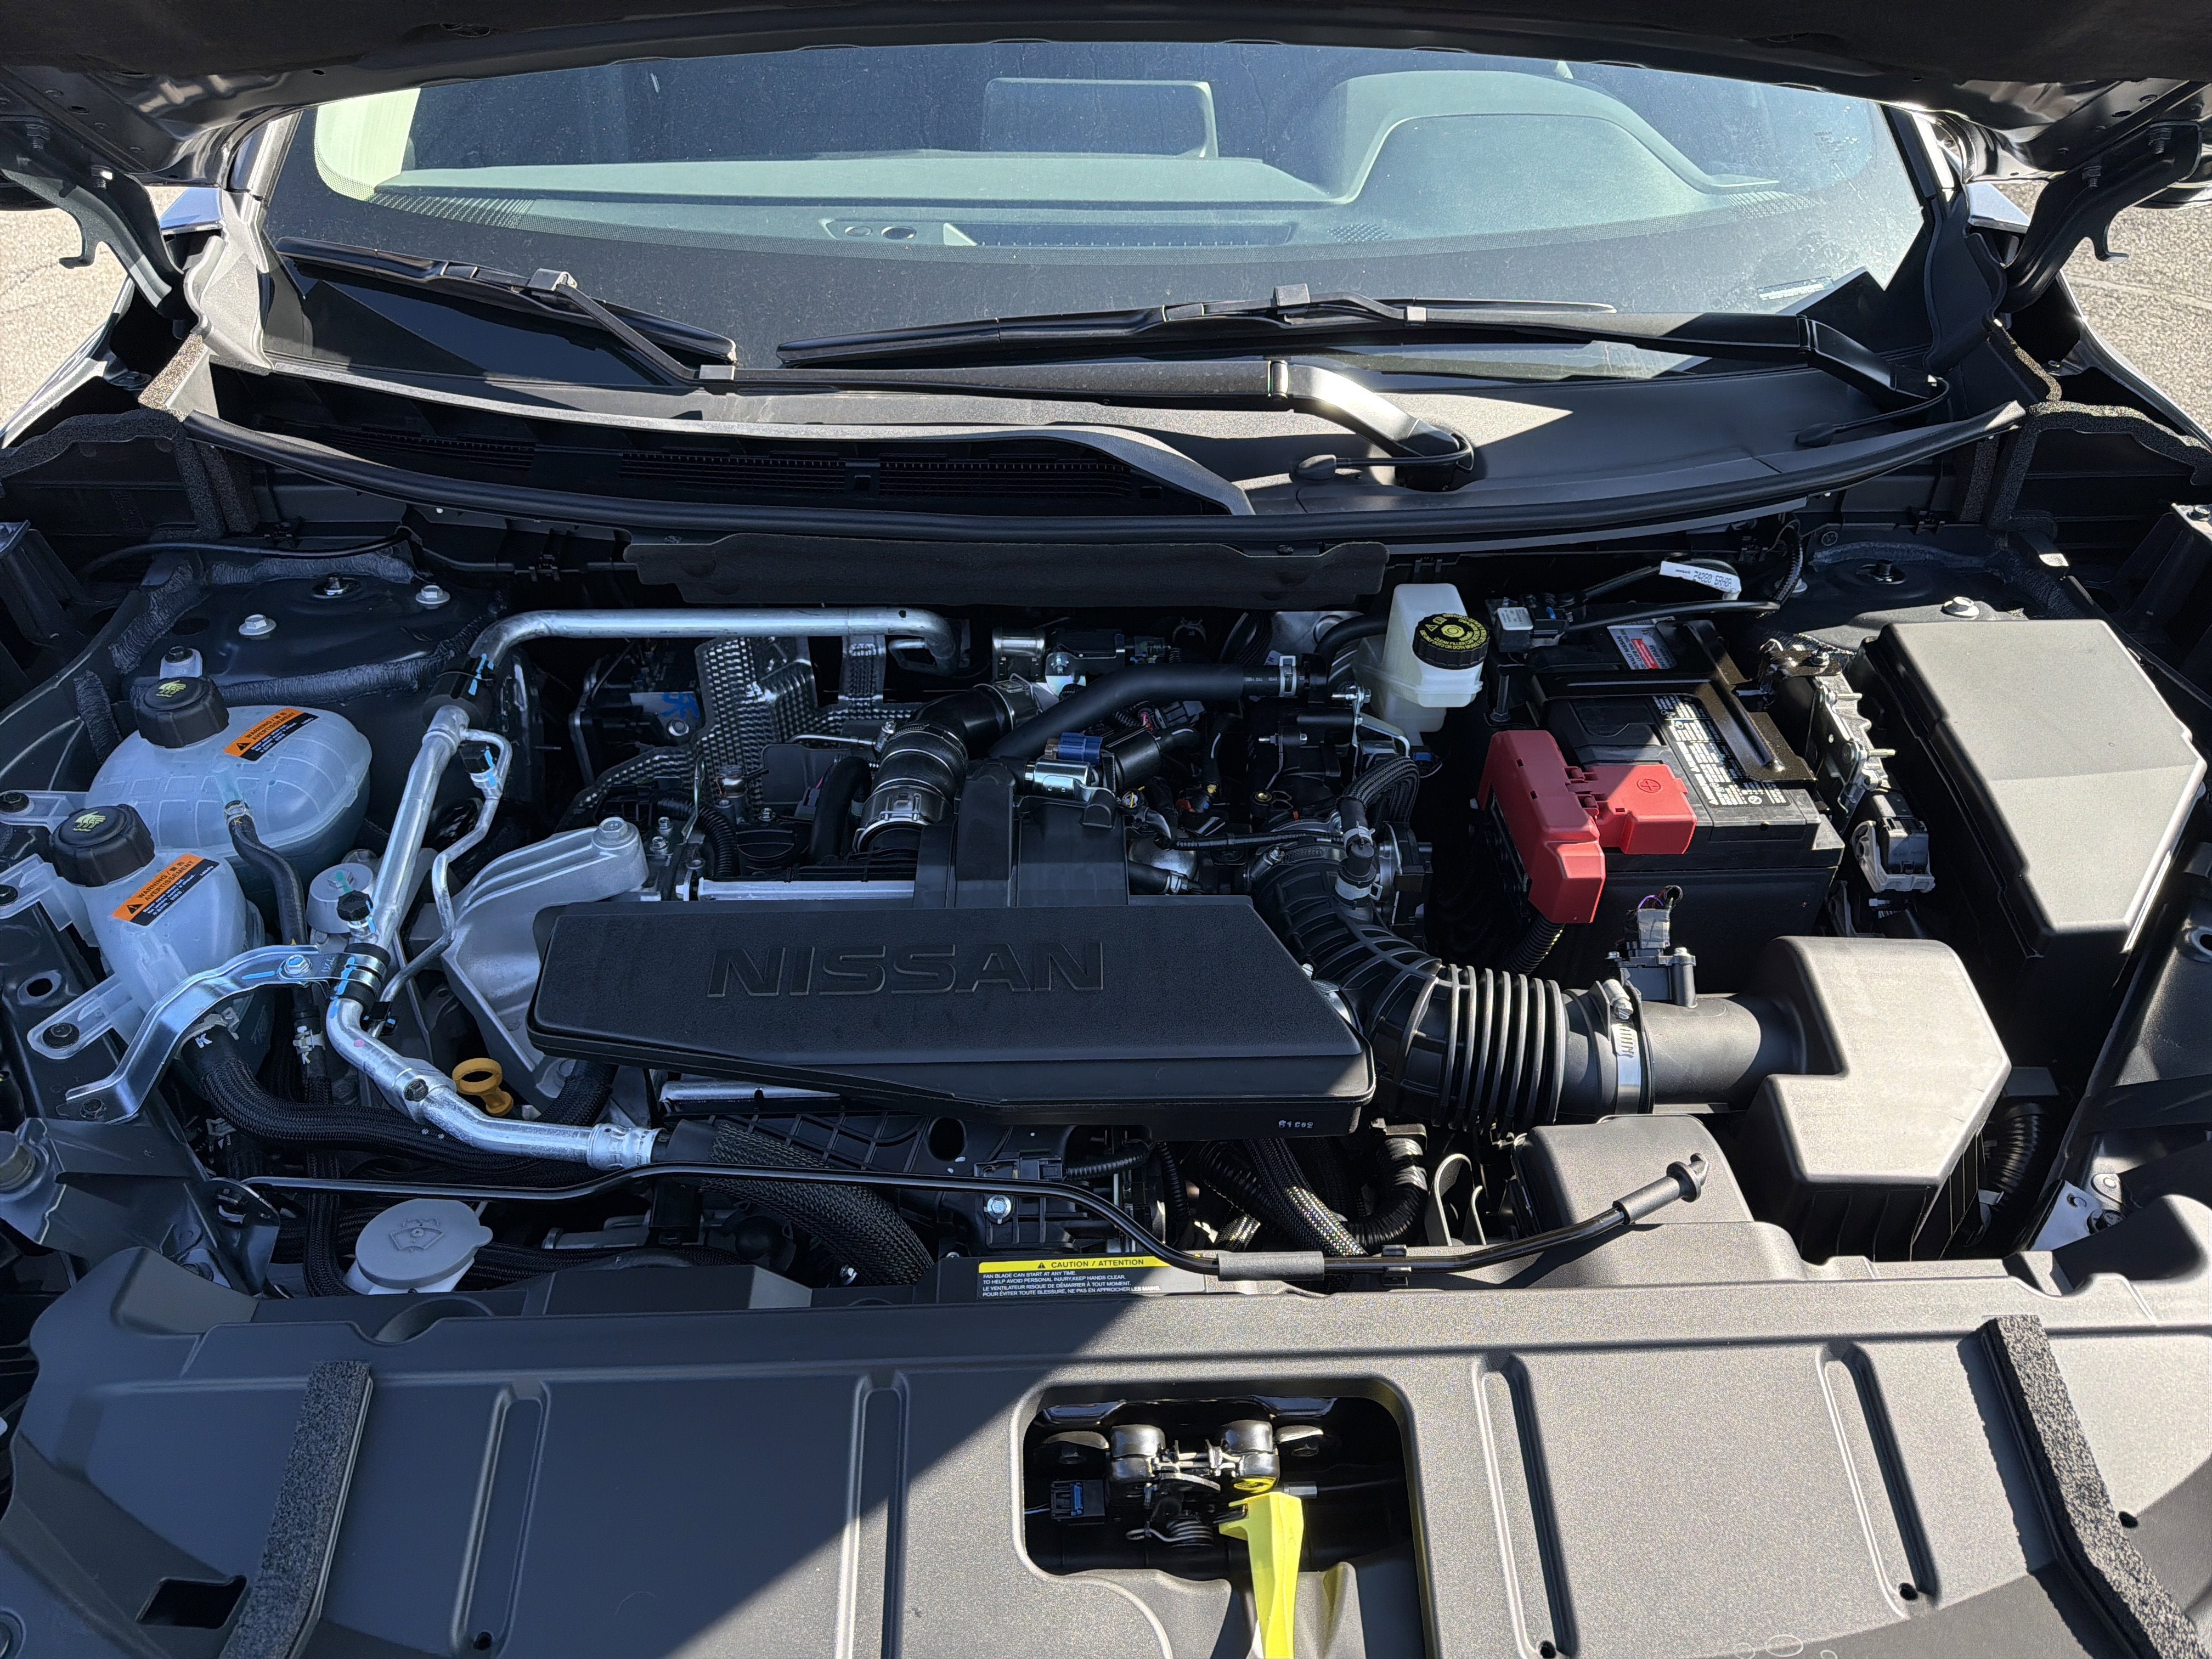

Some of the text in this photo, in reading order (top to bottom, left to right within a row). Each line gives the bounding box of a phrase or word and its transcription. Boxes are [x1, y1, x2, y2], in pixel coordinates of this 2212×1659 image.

[245, 720, 272, 738] WARNING
[252, 712, 297, 741] AVERTISSEMENT
[137, 874, 168, 899] WARNING
[144, 860, 194, 901] AVERTISSEMENT
[707, 942, 1103, 997] NISSAN
